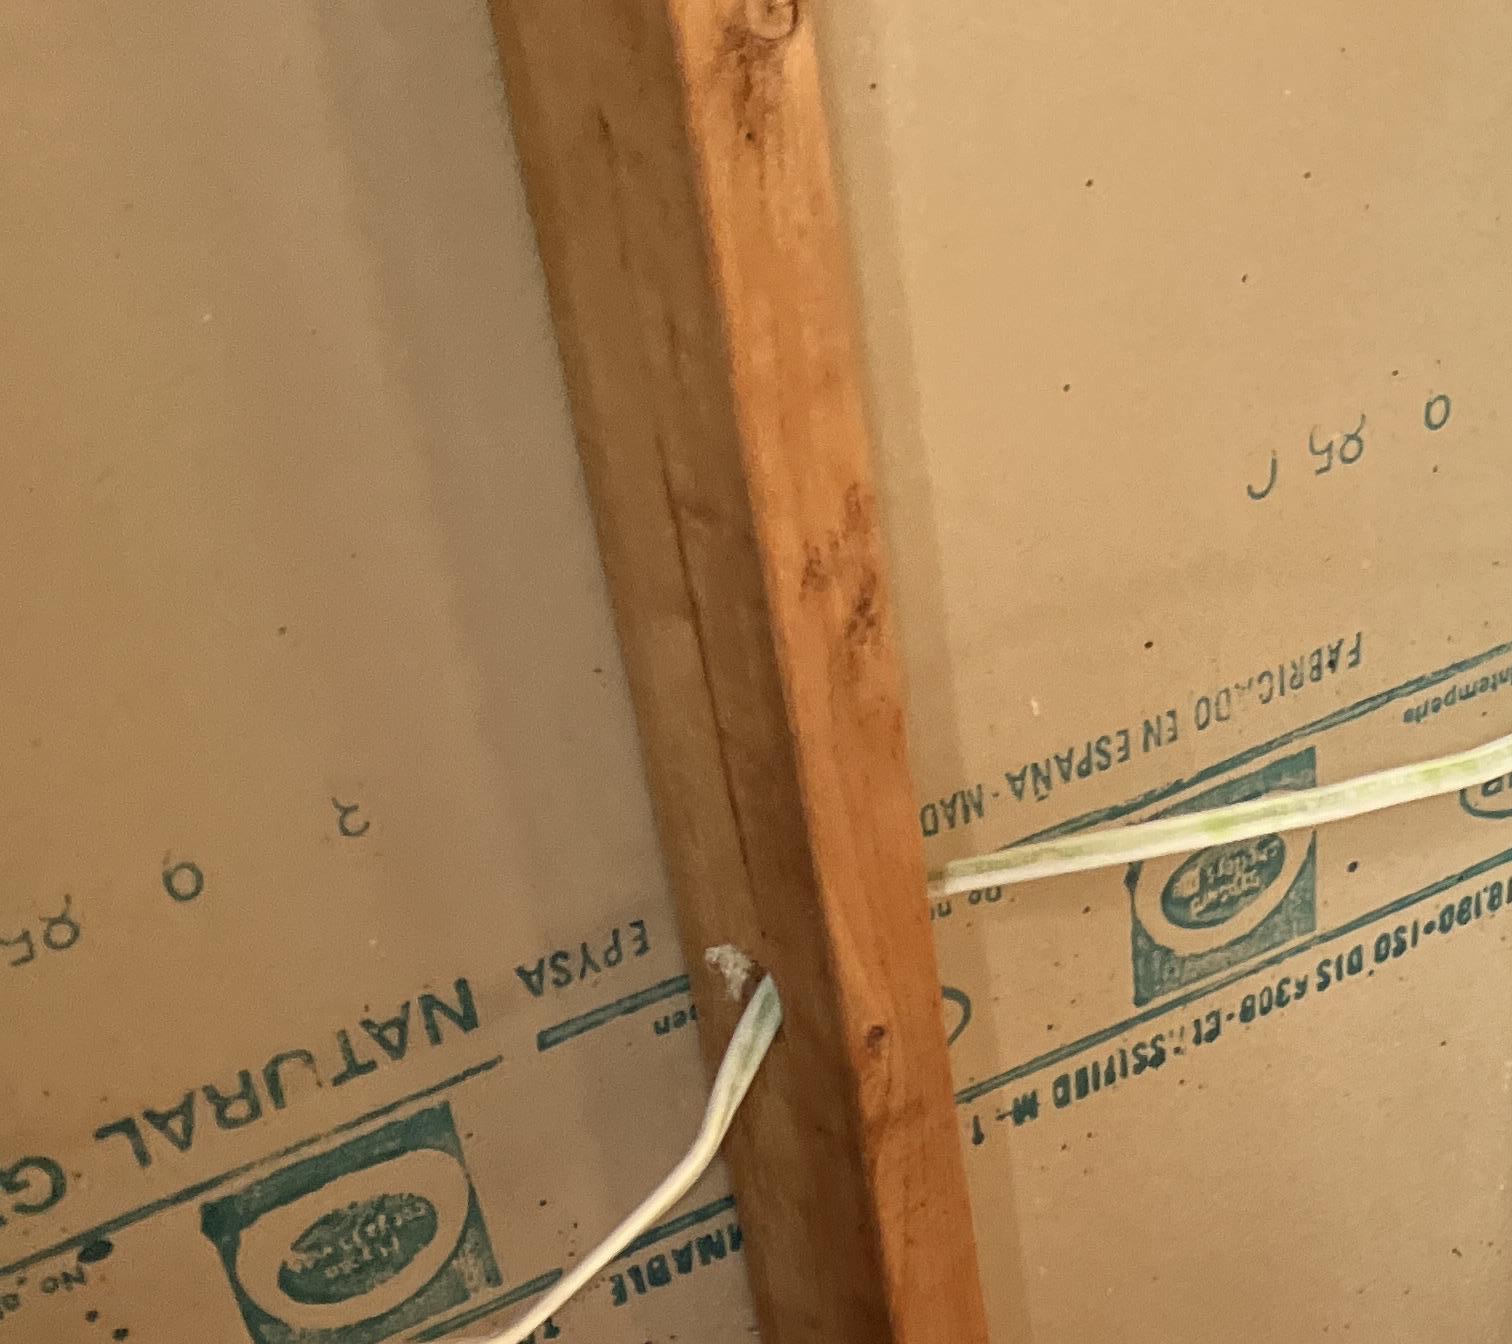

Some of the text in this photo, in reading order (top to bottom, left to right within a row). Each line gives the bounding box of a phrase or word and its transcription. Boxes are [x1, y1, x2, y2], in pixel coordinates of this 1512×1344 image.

[1003, 724, 1133, 799] ESPAÑA
[1139, 706, 1181, 755] EN
[517, 919, 650, 1000] EPYSA
[1315, 944, 1365, 992] DIS
[94, 975, 481, 1169] NATURAL
